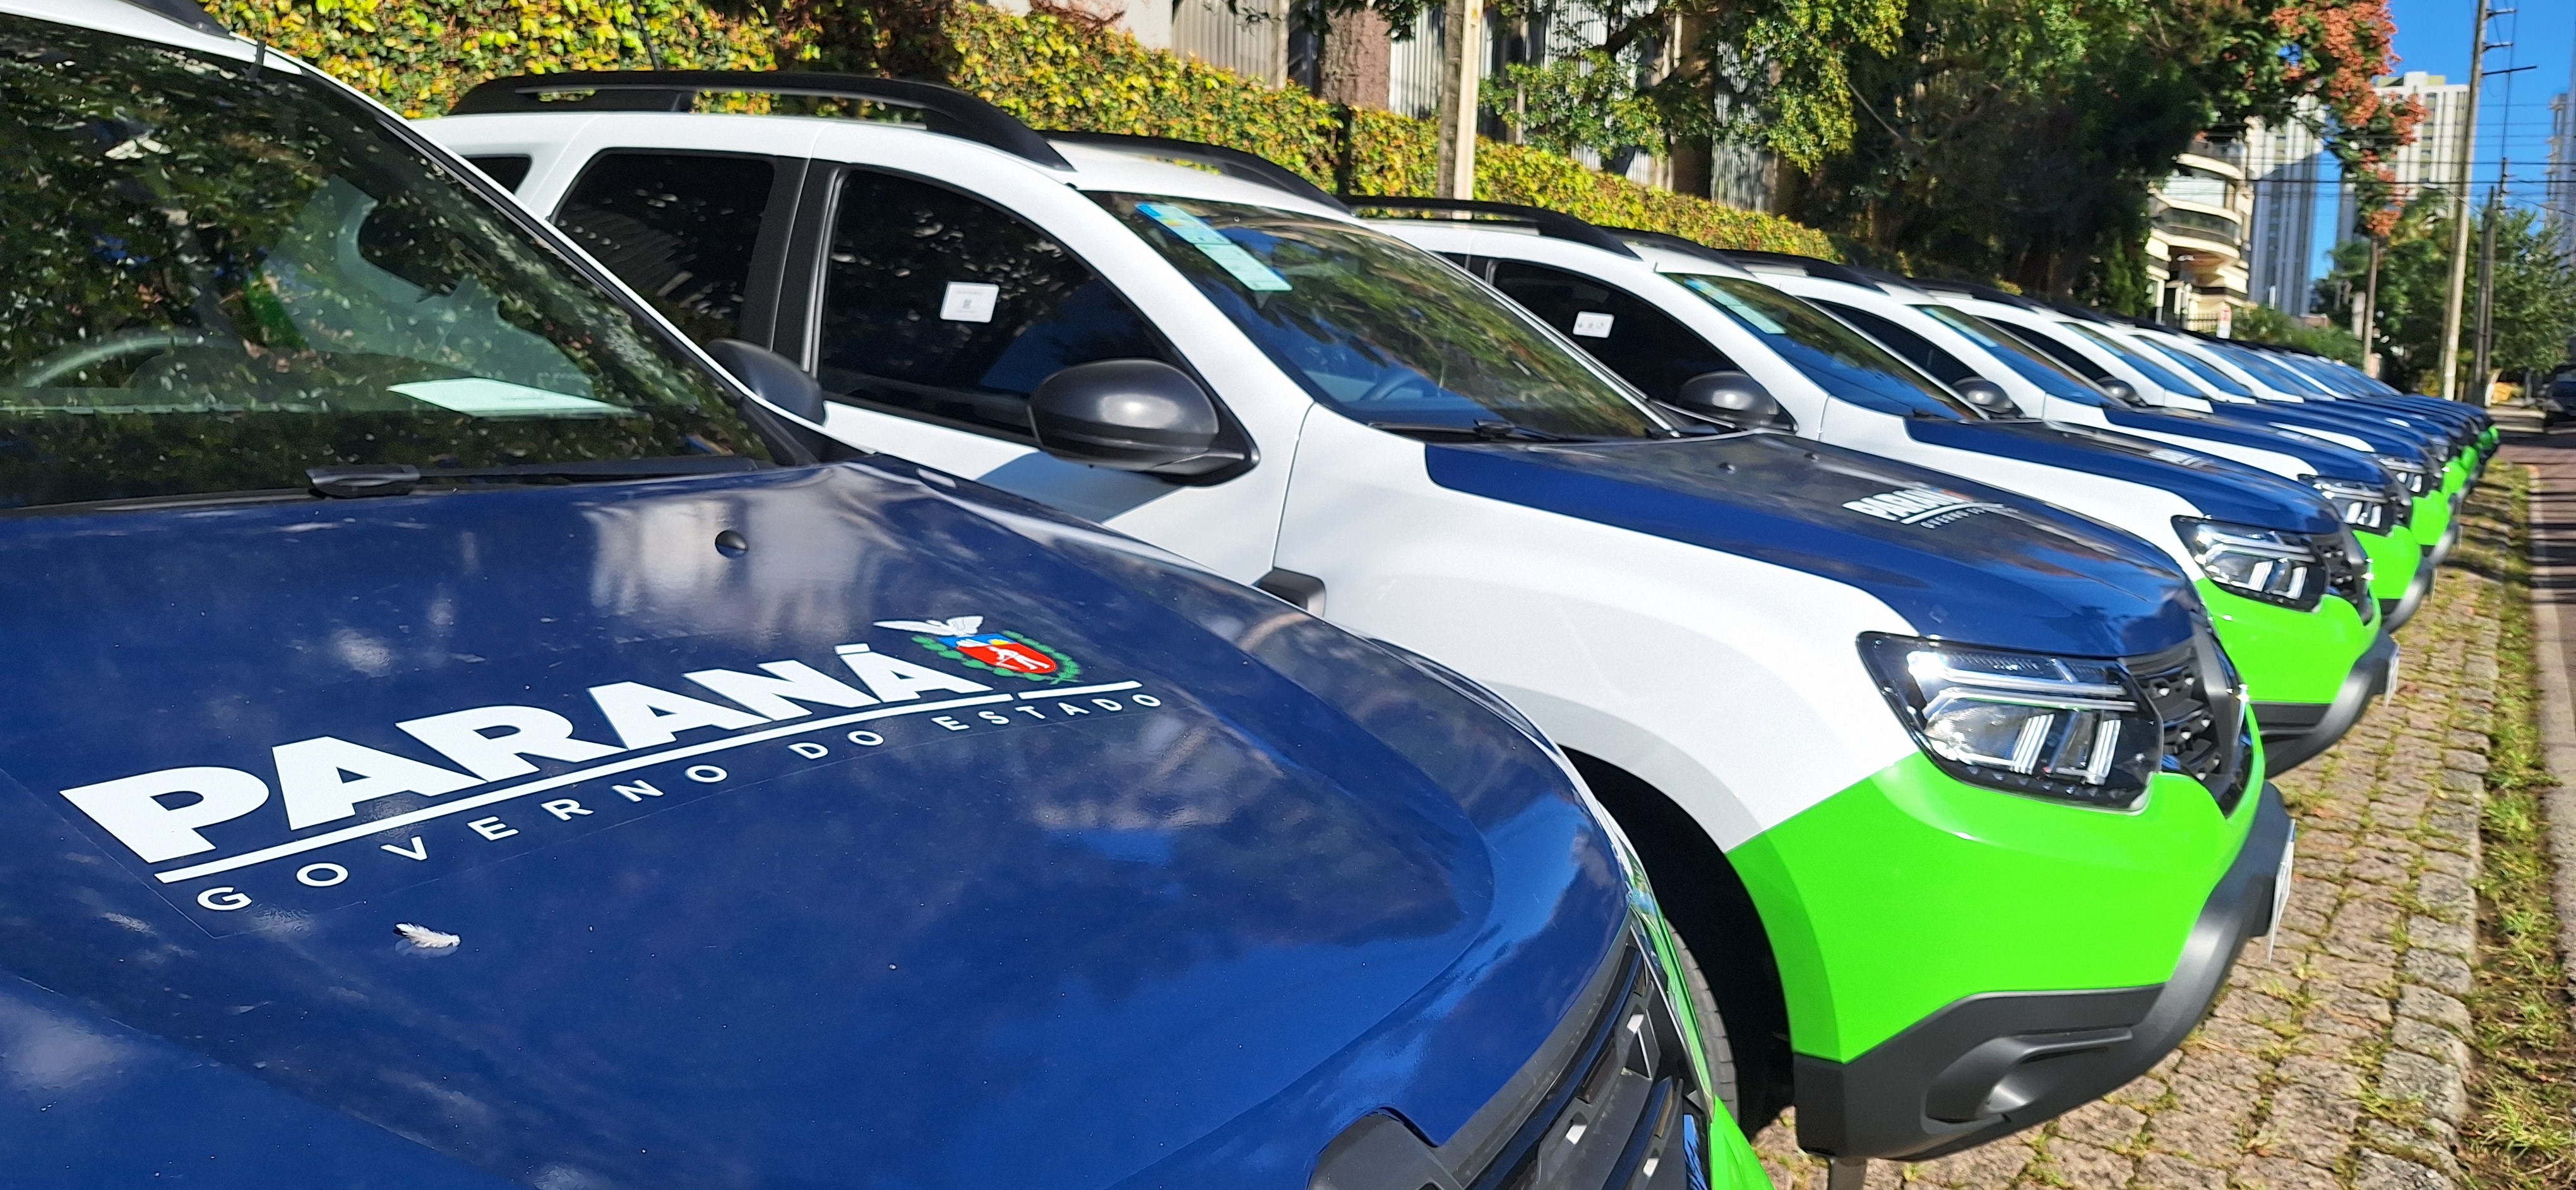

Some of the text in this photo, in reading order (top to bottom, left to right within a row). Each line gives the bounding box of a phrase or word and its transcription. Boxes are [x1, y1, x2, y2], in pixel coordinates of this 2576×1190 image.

[59, 644, 993, 863] PARANÁ
[197, 693, 1162, 911] GOVERNO DO ESTADO
